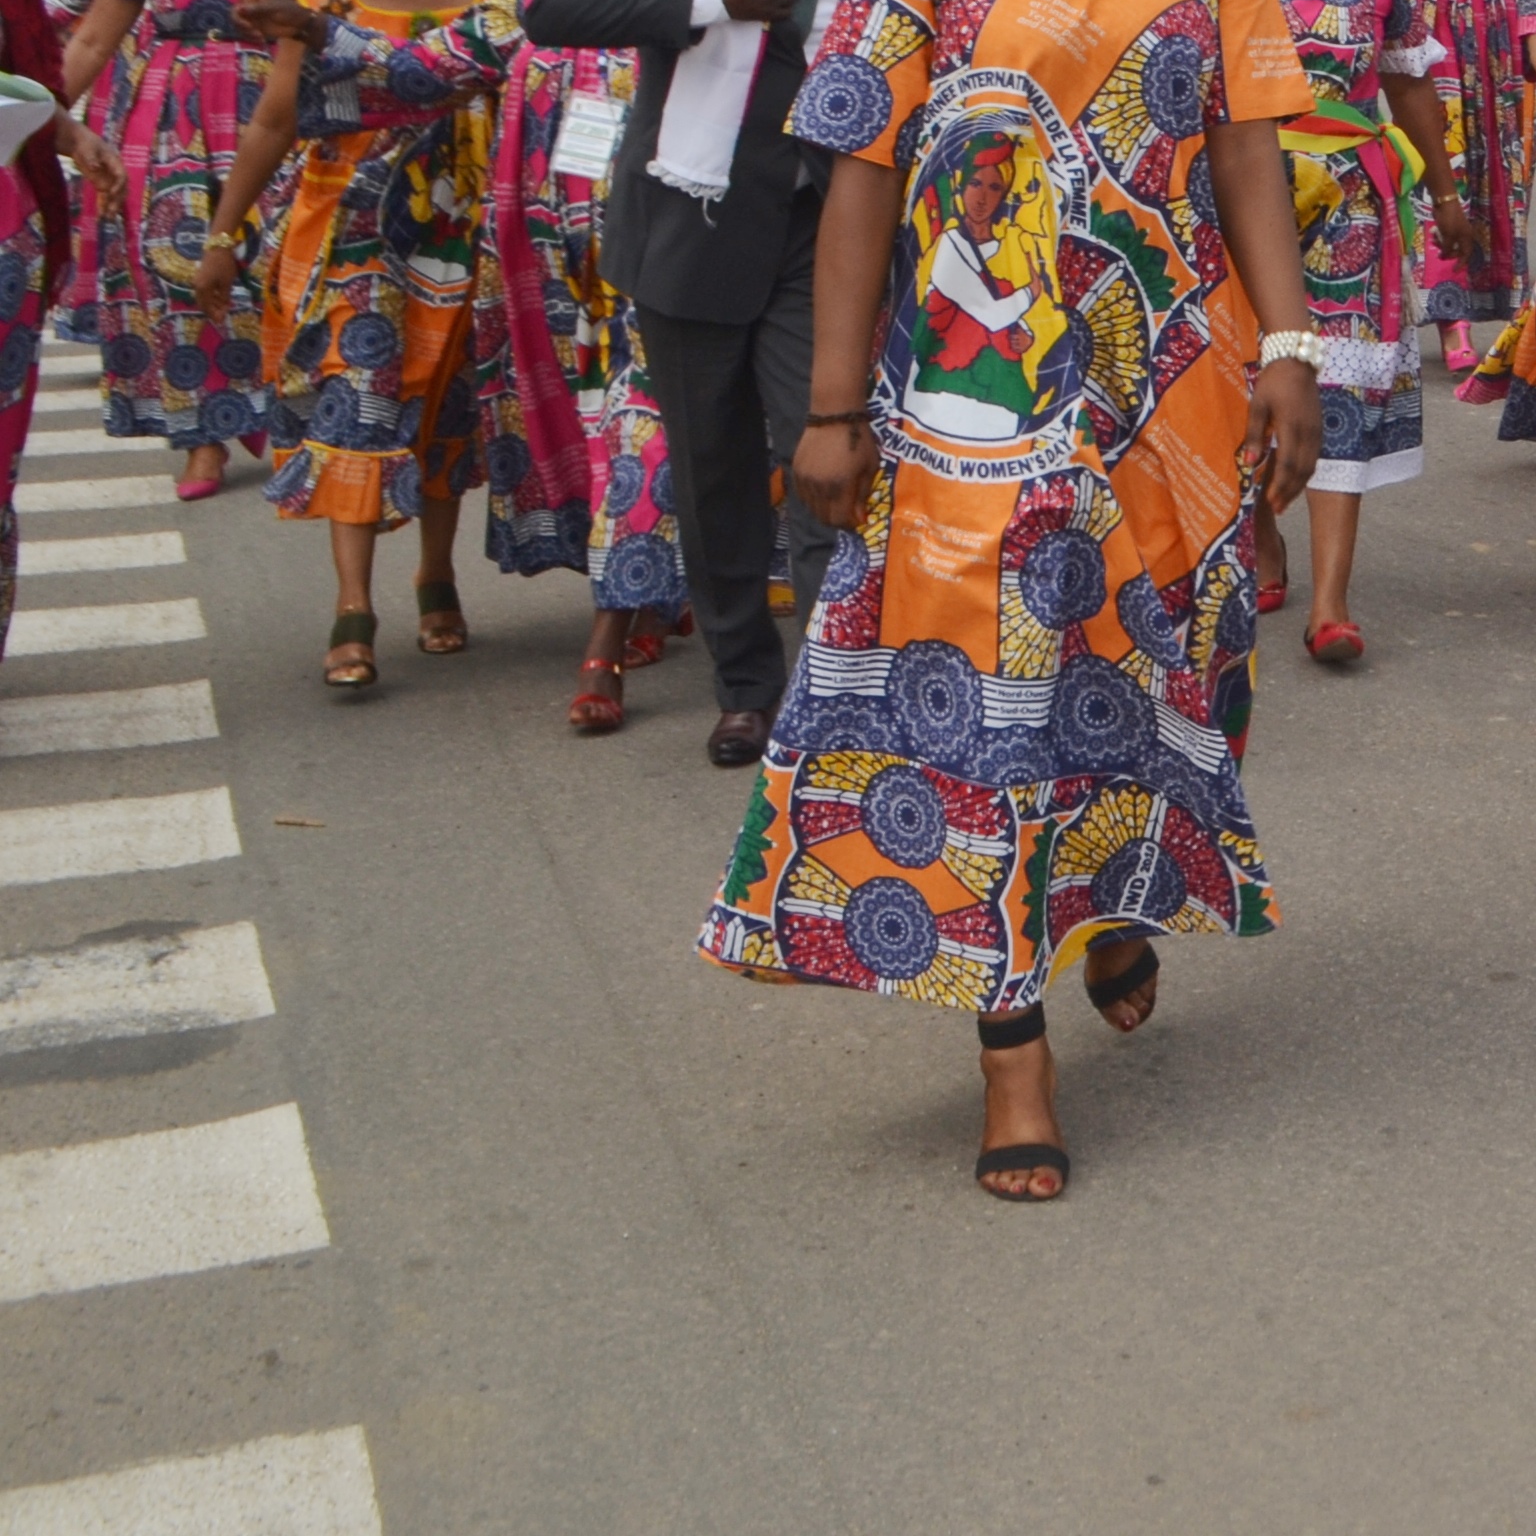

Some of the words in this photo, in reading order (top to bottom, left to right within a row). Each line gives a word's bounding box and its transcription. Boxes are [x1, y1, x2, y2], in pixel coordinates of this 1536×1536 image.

[1046, 124, 1064, 145] DE
[1057, 145, 1078, 164] LA
[1066, 166, 1087, 230] FEMME
[960, 455, 1045, 479] WOMEN'S
[1046, 436, 1073, 466] DAY
[1121, 877, 1147, 913] IWD
